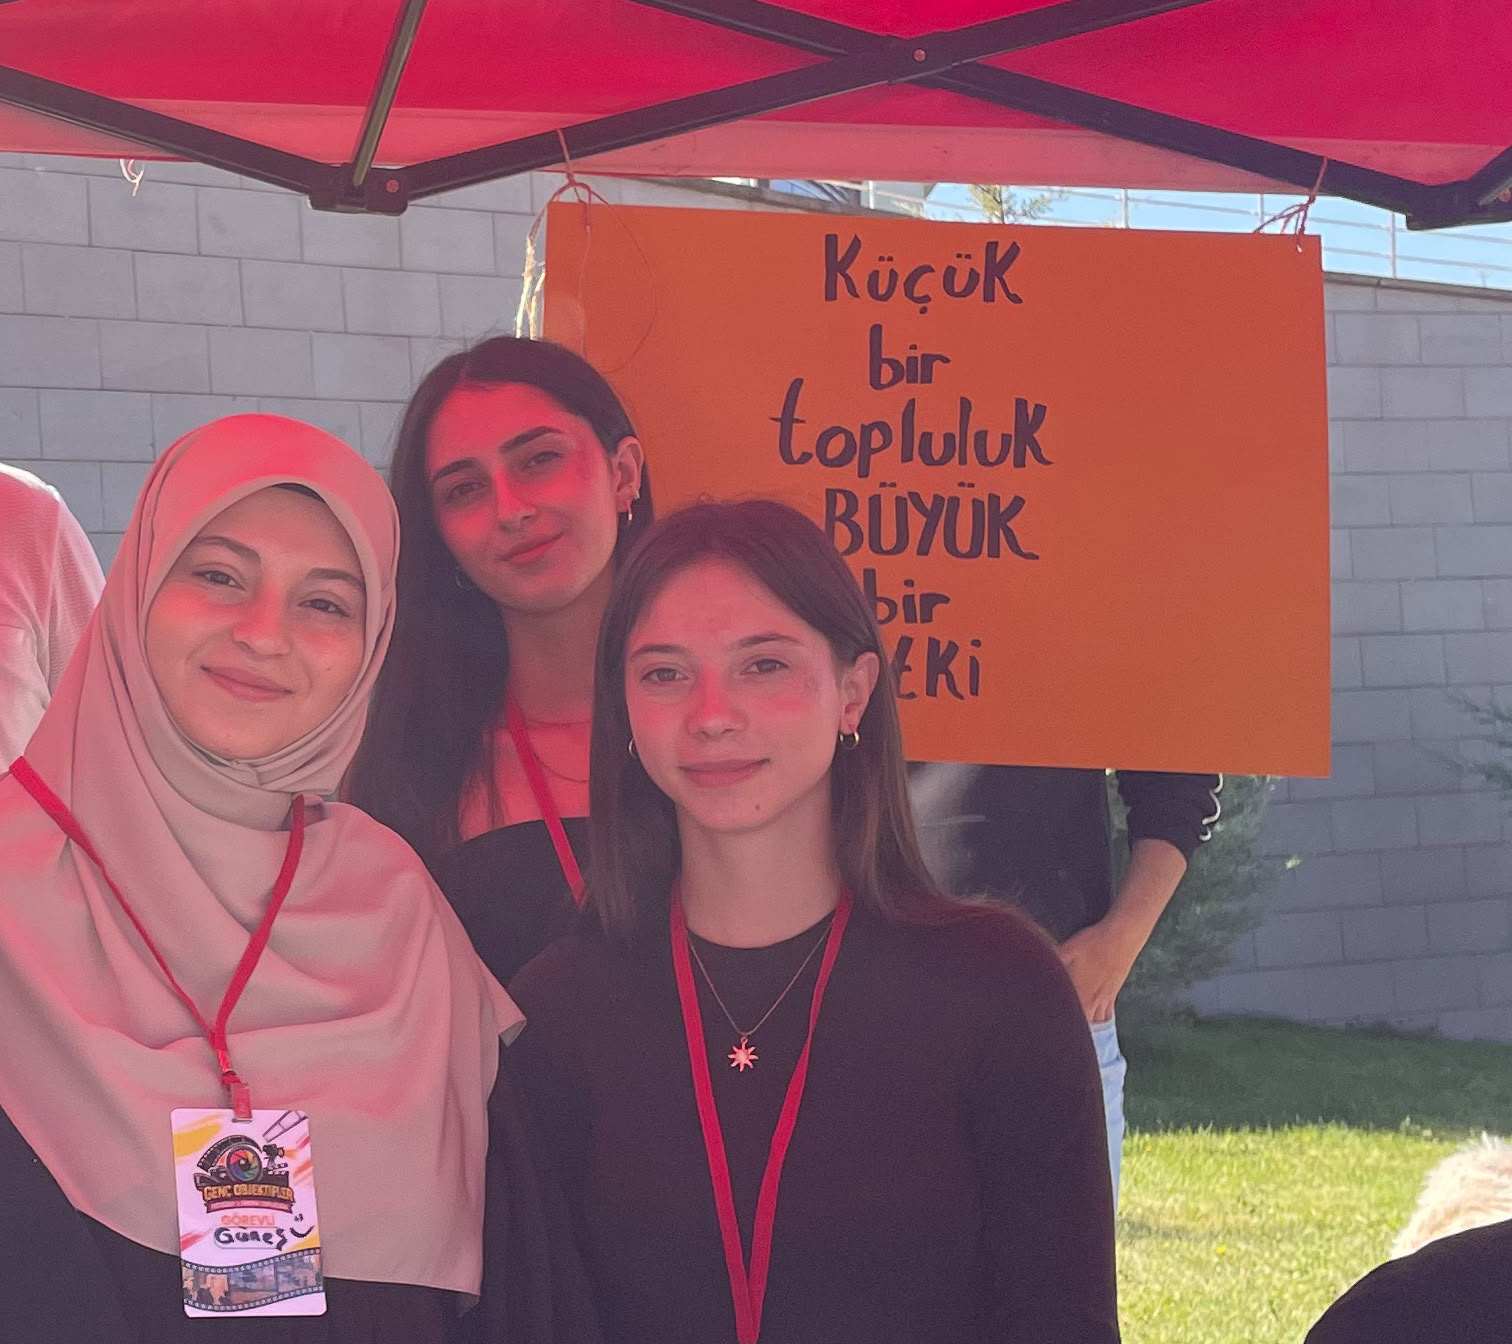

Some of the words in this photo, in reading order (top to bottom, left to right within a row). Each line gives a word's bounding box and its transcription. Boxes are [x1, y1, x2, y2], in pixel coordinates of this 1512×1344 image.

[869, 323, 951, 390] bir
[824, 482, 1040, 560] BÜYÜK
[863, 568, 951, 625] bir
